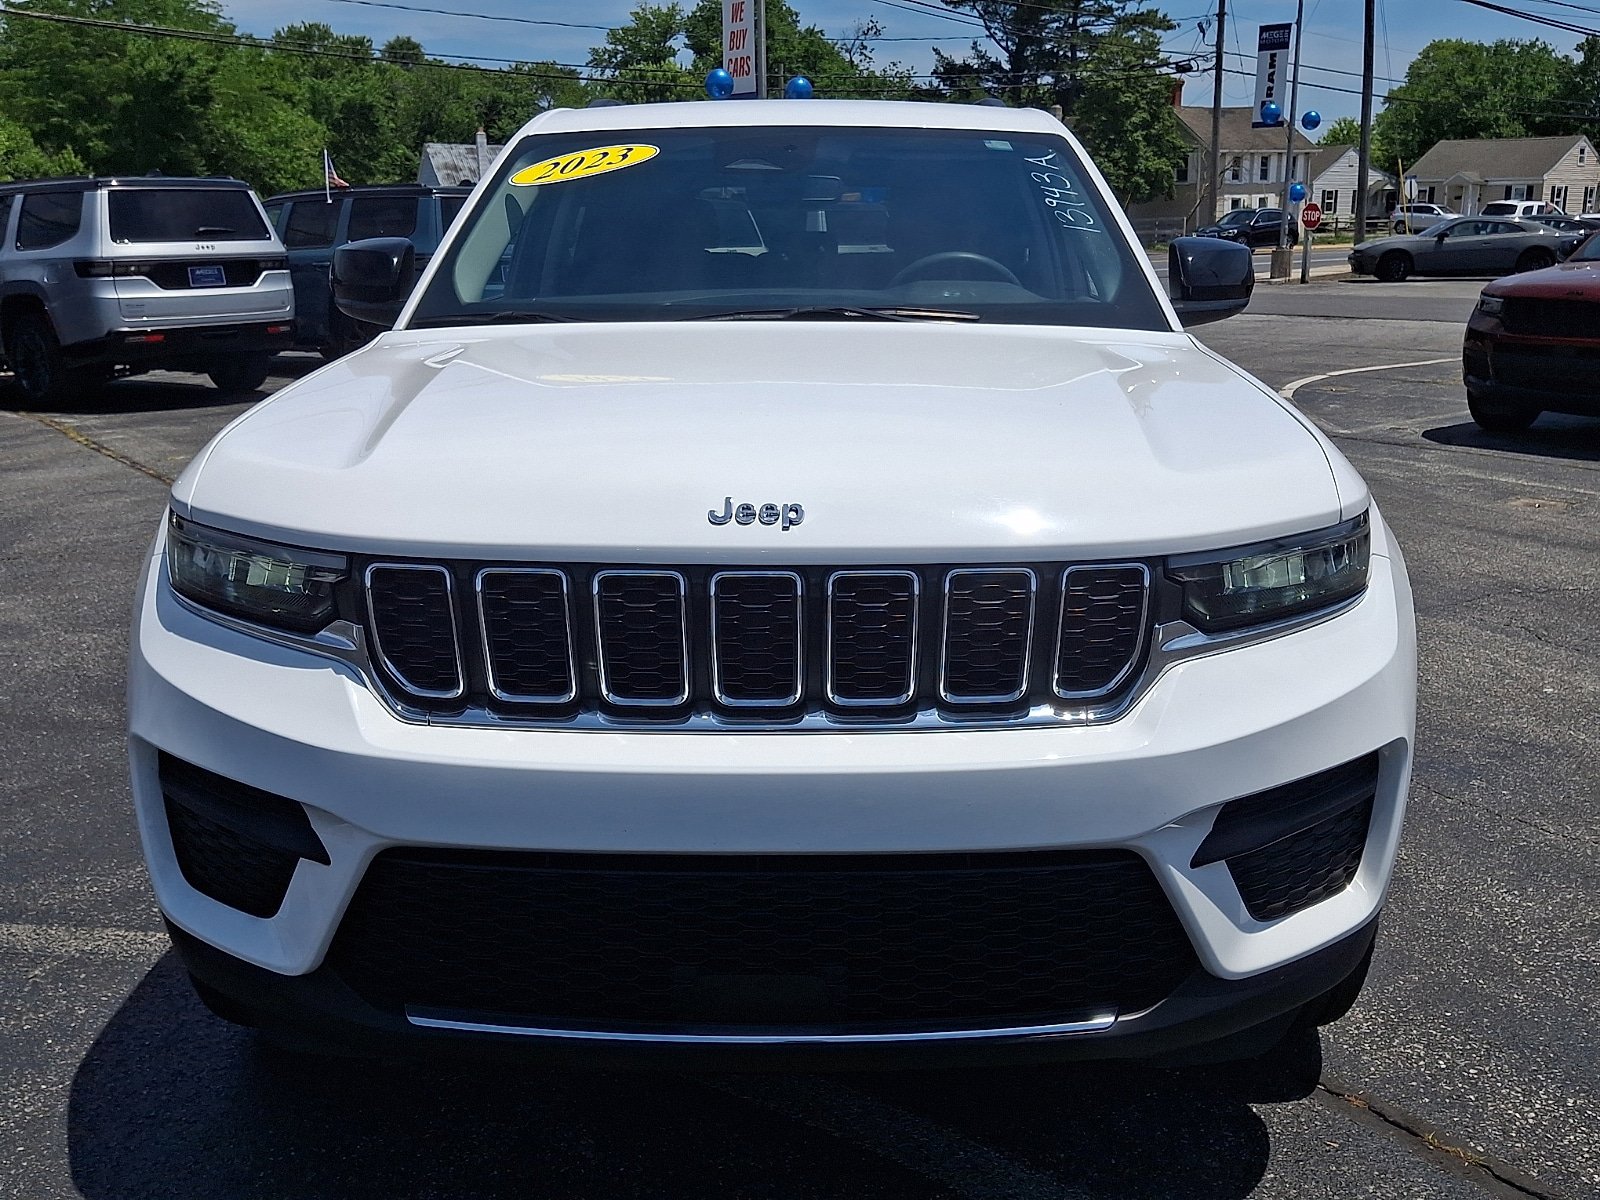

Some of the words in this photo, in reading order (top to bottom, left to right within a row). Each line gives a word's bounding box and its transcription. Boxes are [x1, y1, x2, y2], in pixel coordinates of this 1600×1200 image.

[731, 1, 745, 23] WE
[729, 28, 748, 51] BUY
[727, 56, 751, 77] CARS
[1266, 52, 1278, 98] RAM
[533, 147, 634, 181] 2023
[1302, 210, 1320, 221] STOP
[707, 496, 805, 532] Jeep
